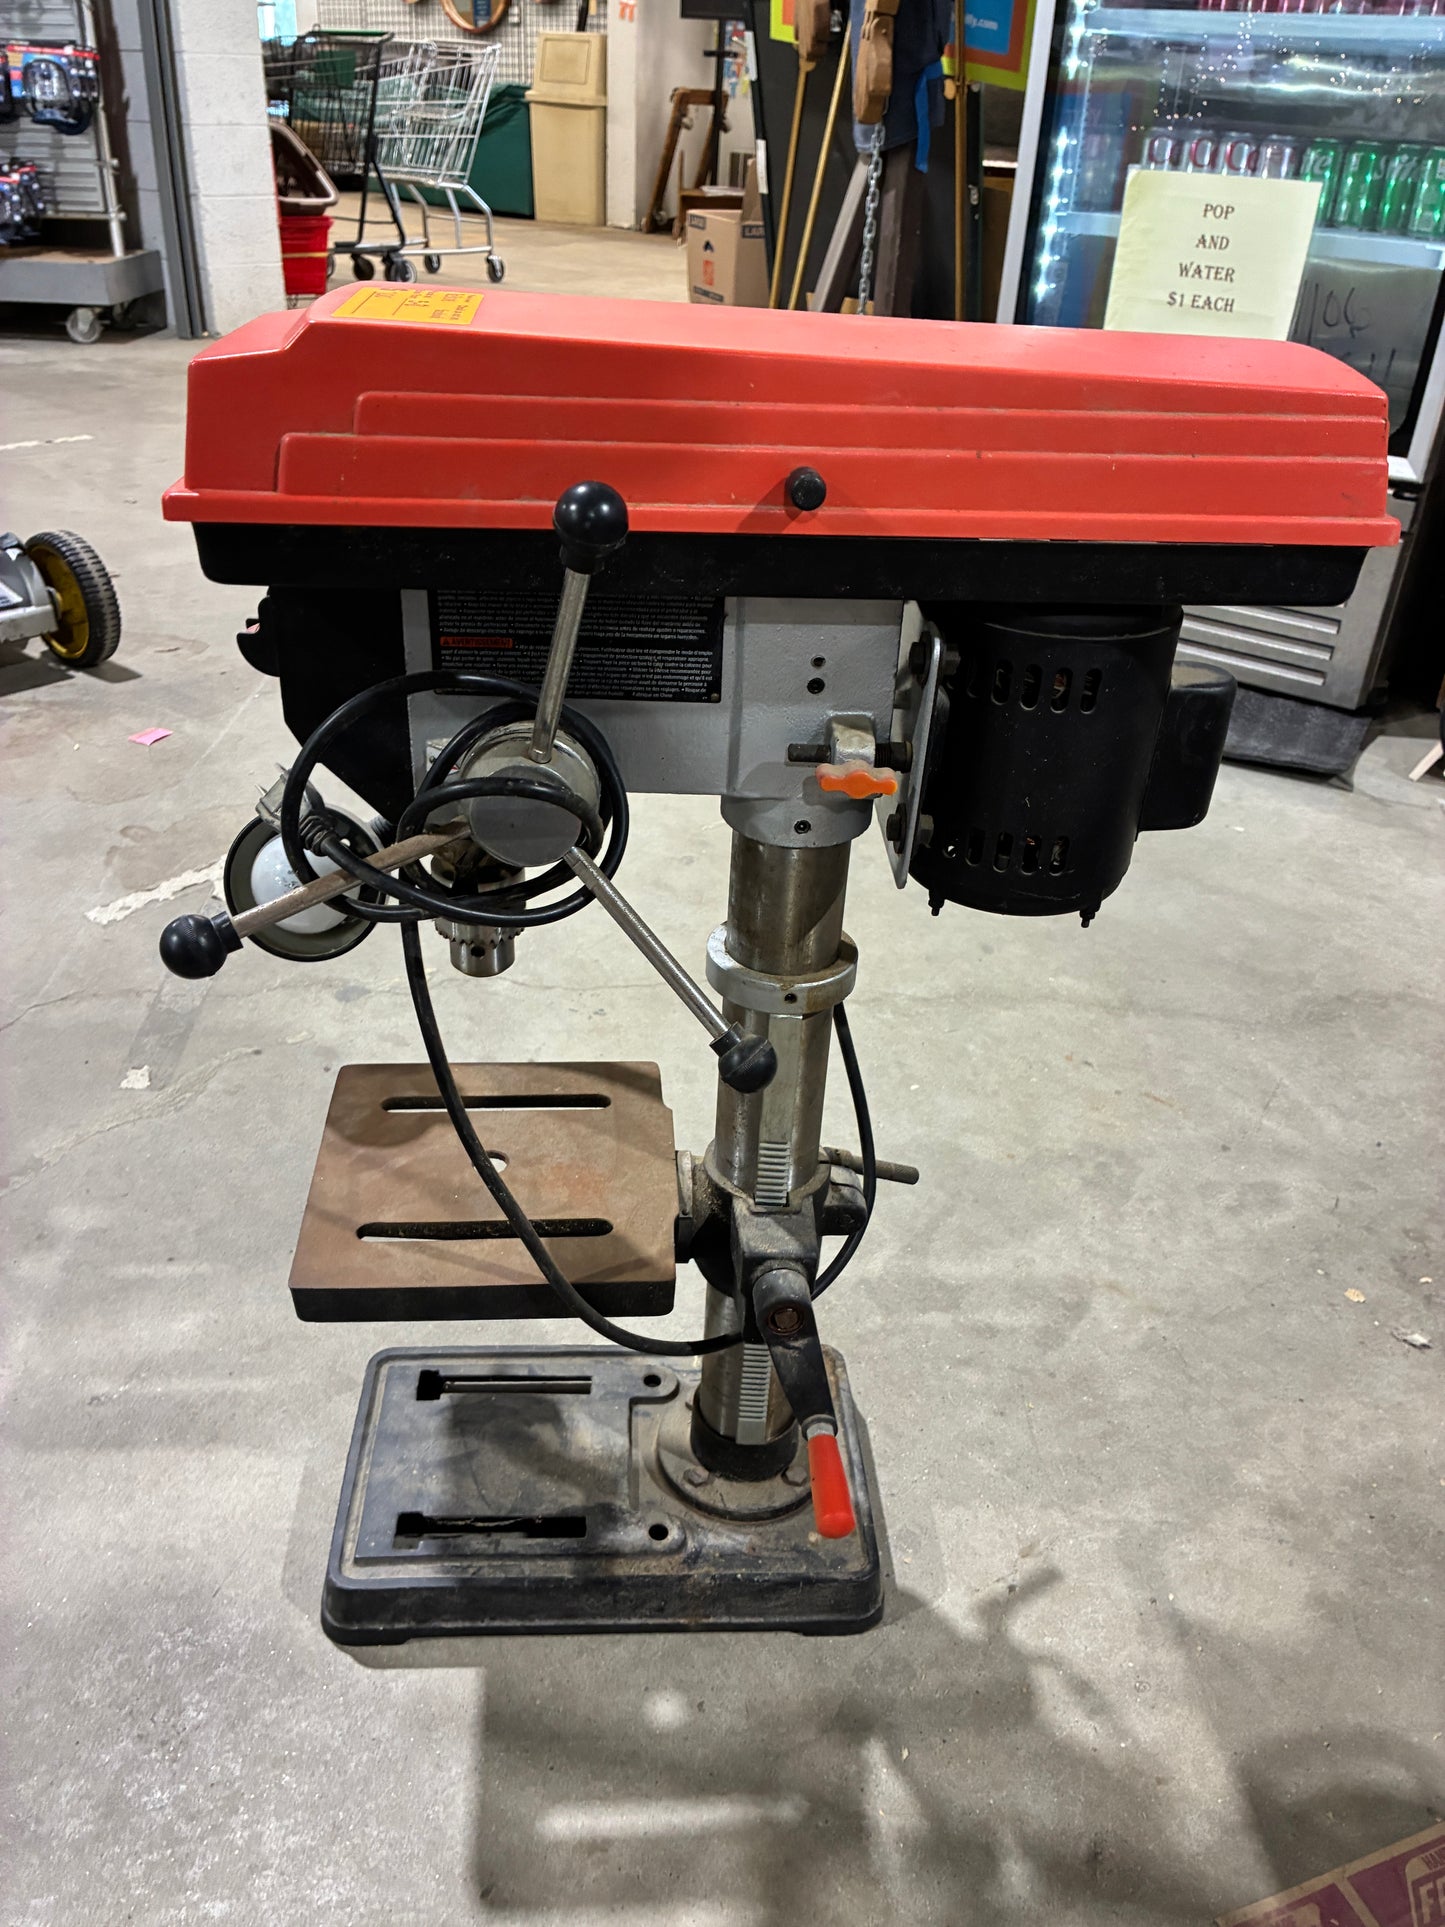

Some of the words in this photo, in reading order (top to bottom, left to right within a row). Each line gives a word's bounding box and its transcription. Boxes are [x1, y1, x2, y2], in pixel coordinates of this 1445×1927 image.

[1202, 203, 1235, 220] POP
[1196, 234, 1229, 251] AND
[1178, 262, 1236, 283] WATER
[1167, 291, 1185, 308] $1
[1191, 294, 1235, 313] EACH
